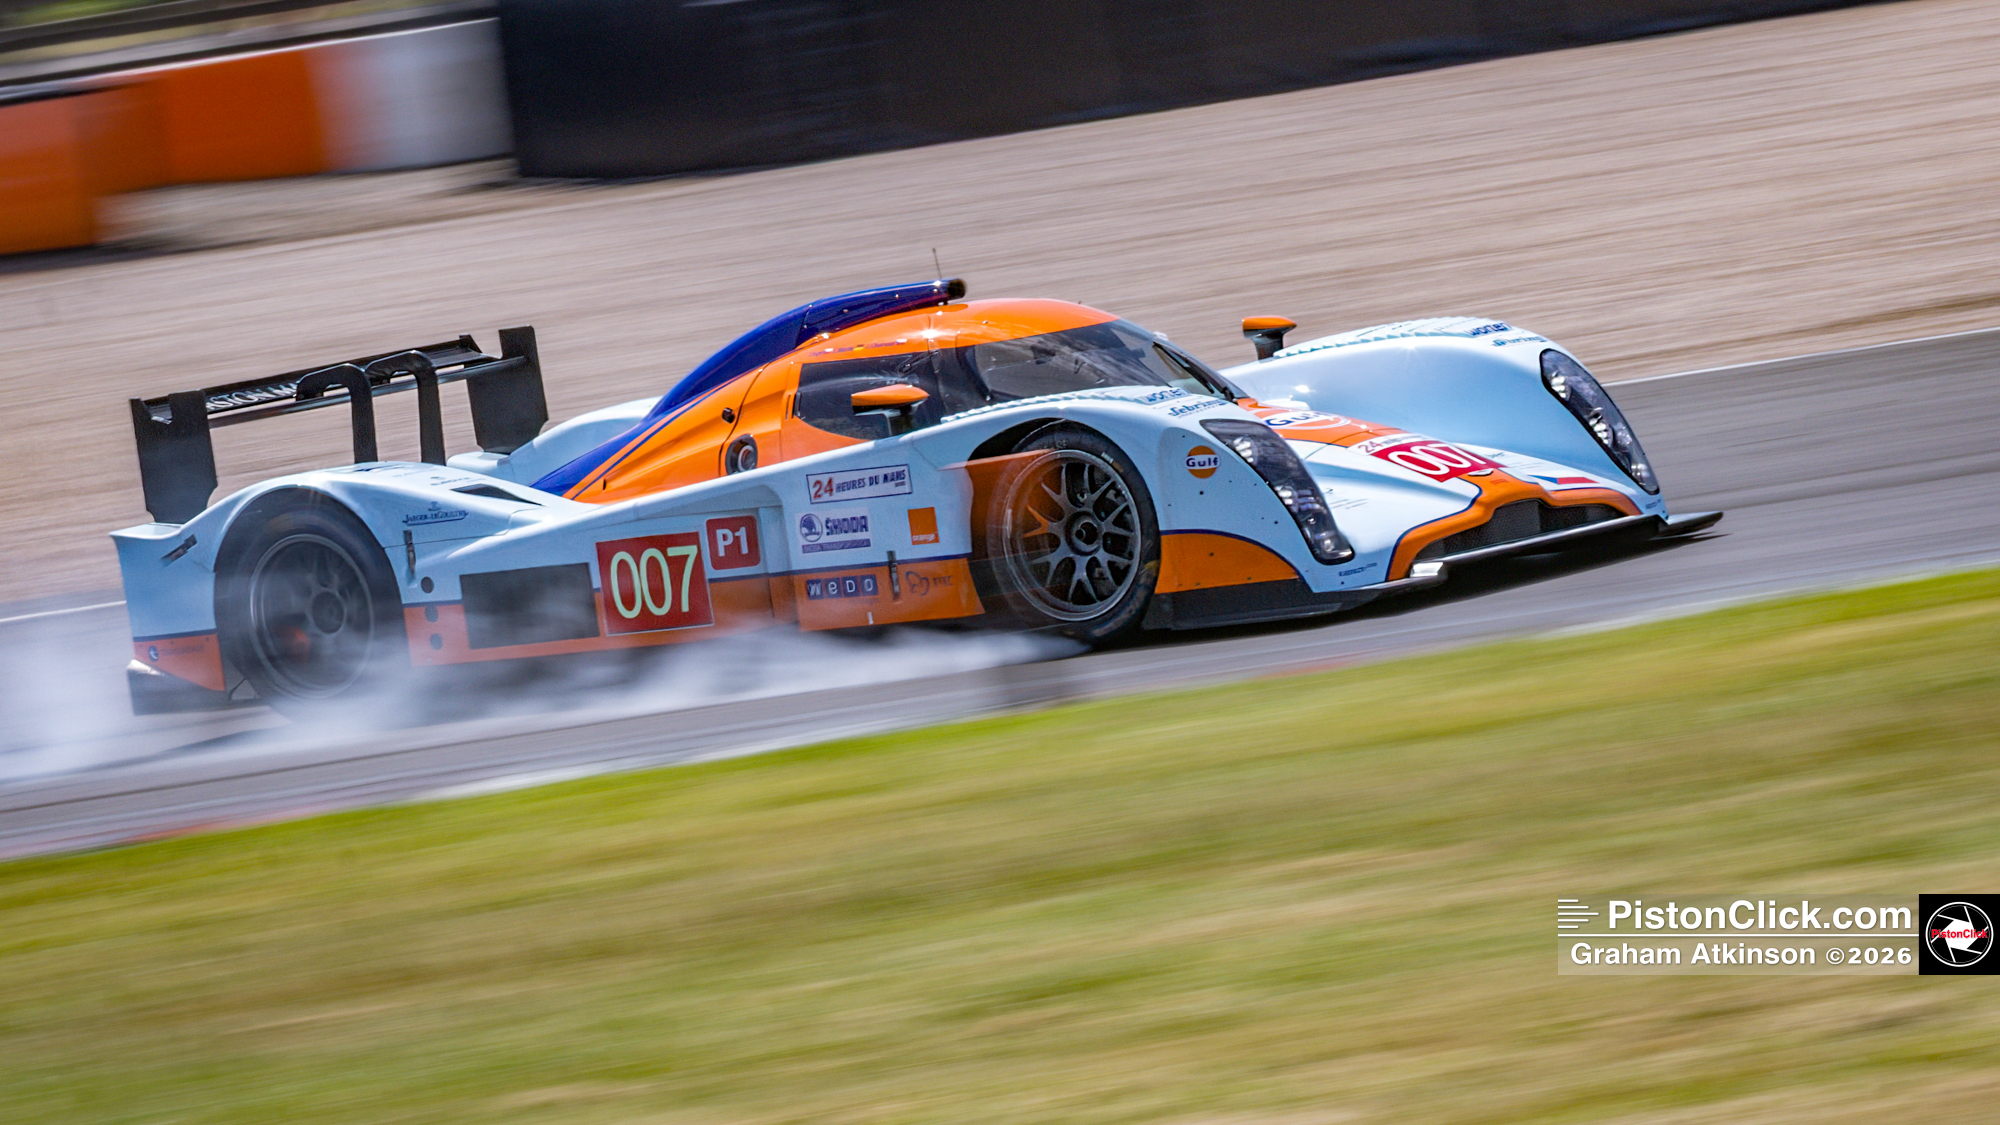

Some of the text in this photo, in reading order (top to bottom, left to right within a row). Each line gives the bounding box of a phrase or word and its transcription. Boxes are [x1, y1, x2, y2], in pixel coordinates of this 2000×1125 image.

[1168, 399, 1228, 417] Sebring
[1357, 440, 1384, 454] 24
[1388, 443, 1487, 475] 007
[1186, 457, 1219, 468] Gulf
[812, 477, 834, 499] 24
[836, 478, 866, 493] HEURES
[868, 475, 880, 487] DU
[883, 469, 906, 484] MANS
[716, 526, 749, 557] P1
[912, 533, 936, 542] orange
[610, 544, 698, 619] 007
